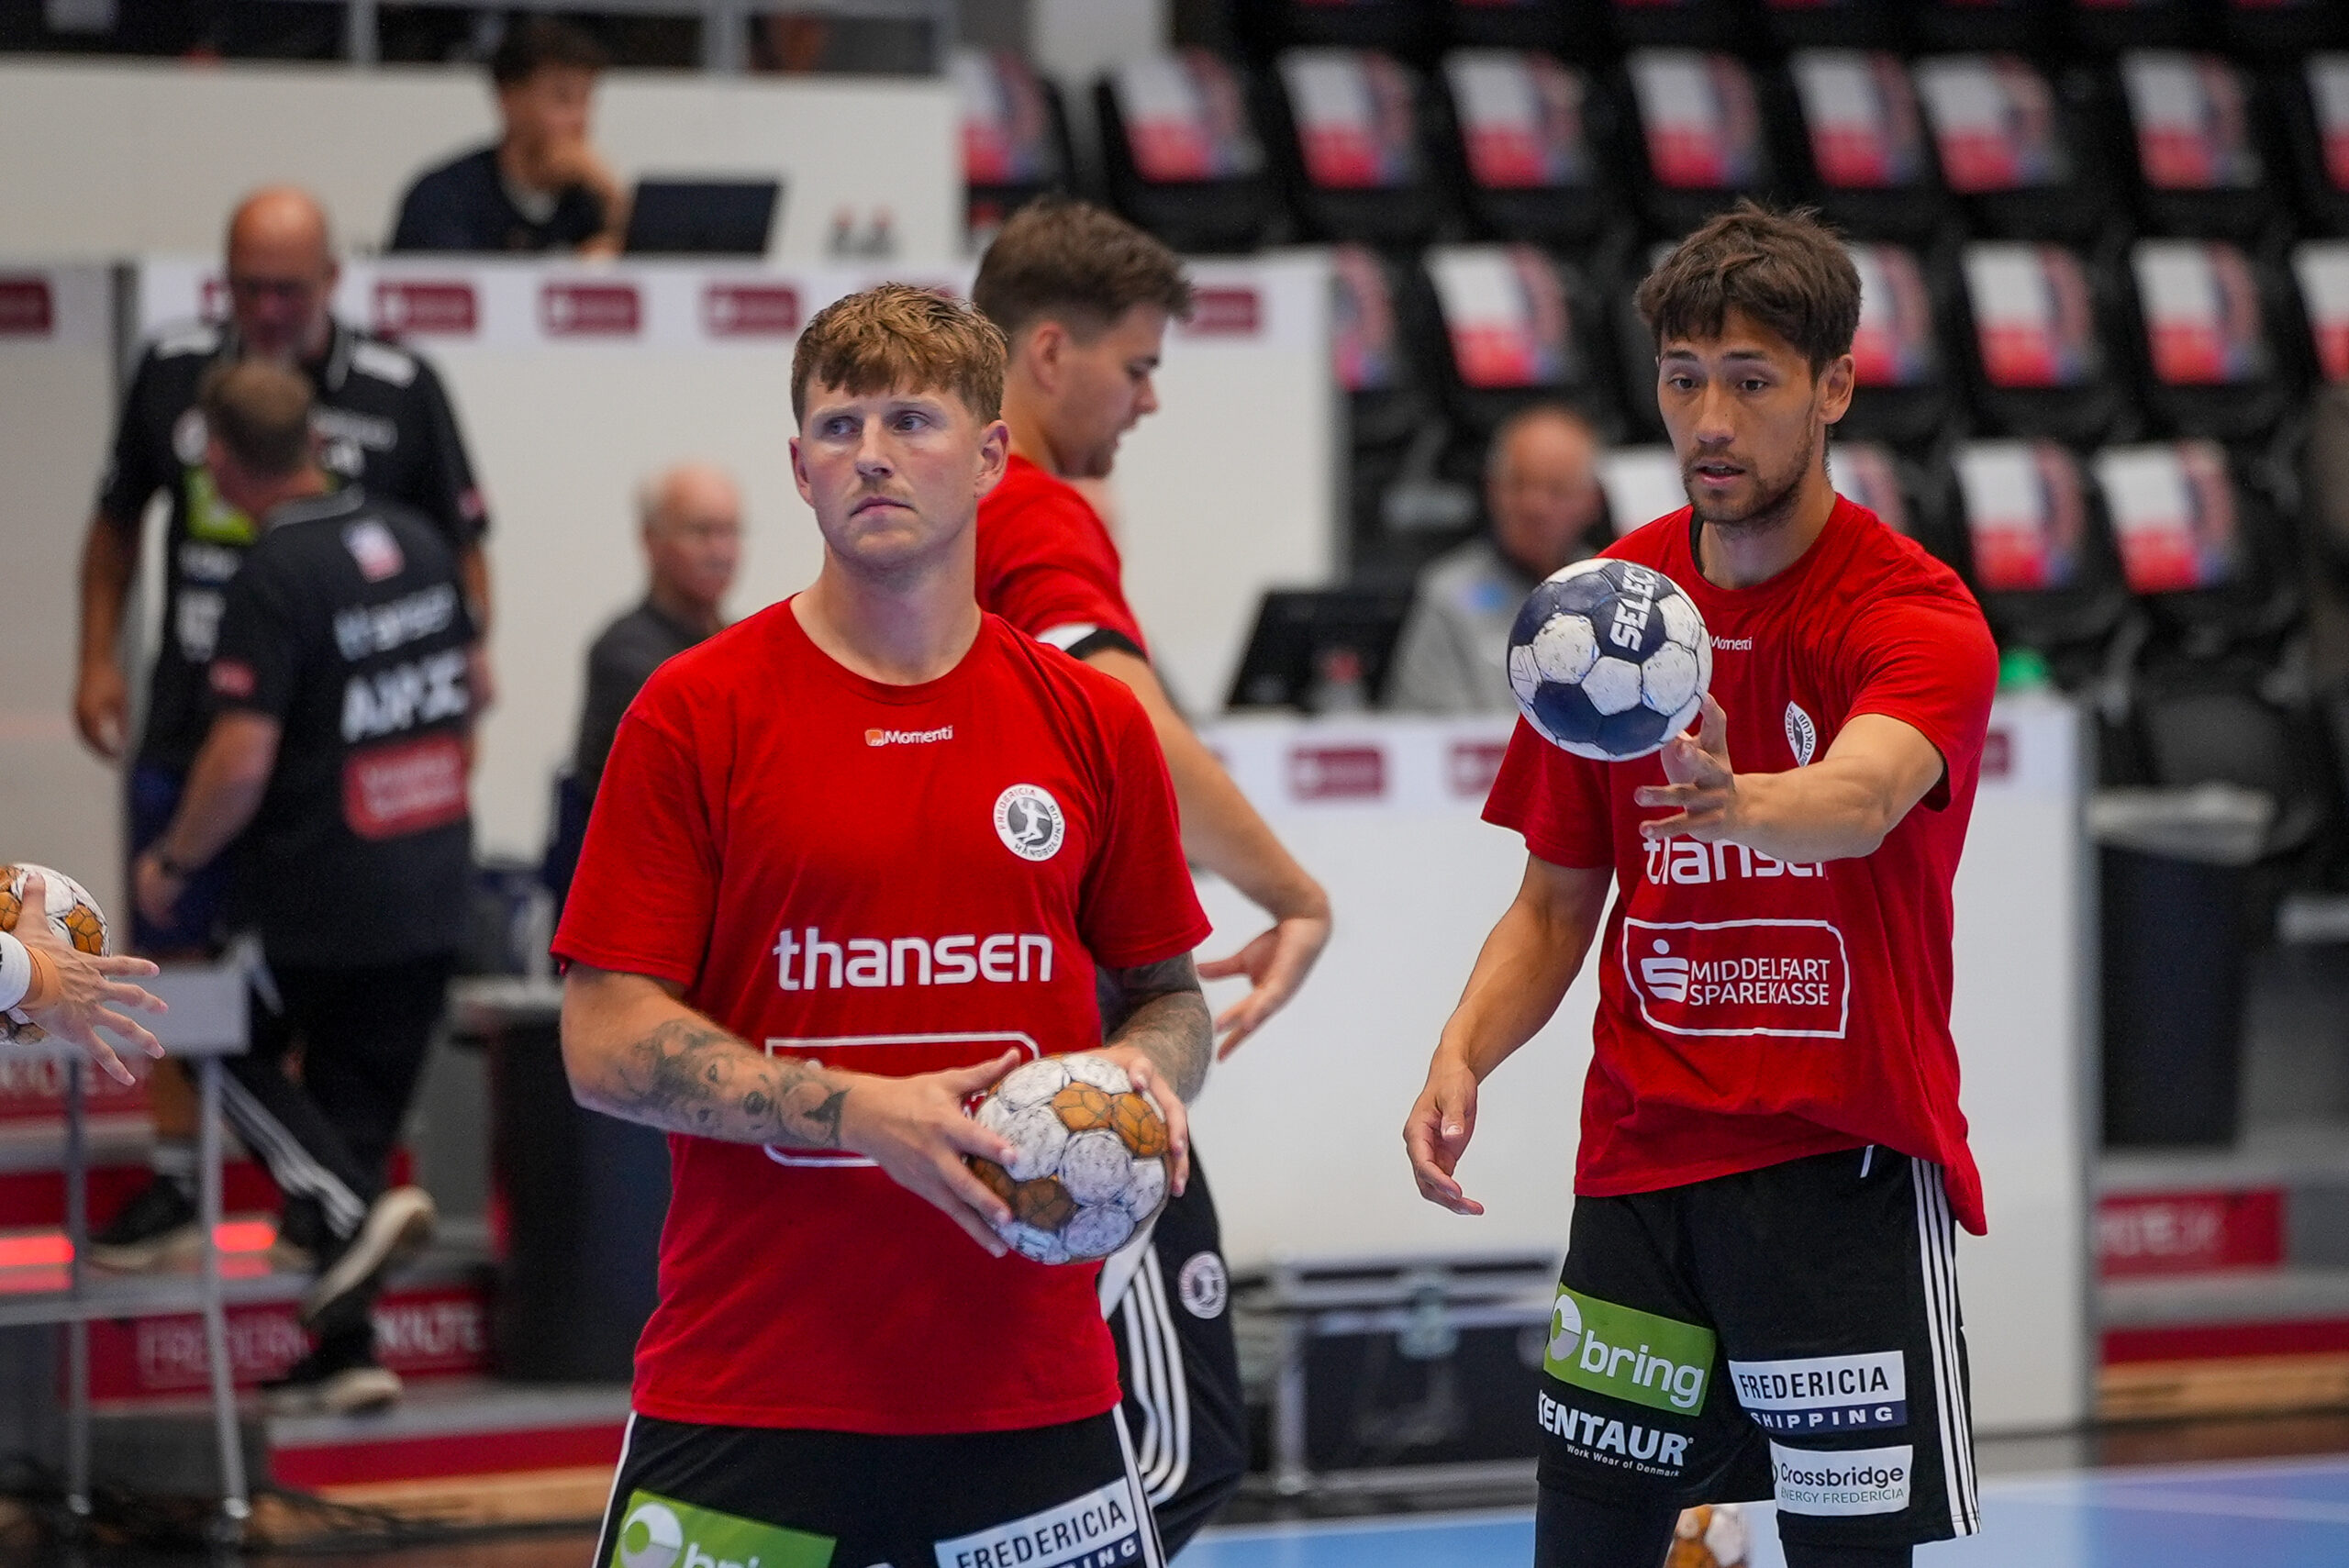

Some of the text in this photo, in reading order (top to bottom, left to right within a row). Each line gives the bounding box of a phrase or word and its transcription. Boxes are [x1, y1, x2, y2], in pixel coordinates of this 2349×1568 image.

[1609, 564, 1656, 652] SELEC
[885, 725, 953, 744] Momenti
[773, 927, 1052, 991] thansen
[1690, 958, 1831, 983] MIDDELFART
[1689, 982, 1830, 1006] SPAREKASSE
[1579, 1329, 1705, 1408] bring
[1738, 1366, 1889, 1399] FREDERICIA
[1750, 1407, 1893, 1429] SHIPPING
[1566, 1443, 1680, 1477] Work Wear of Denmark
[1781, 1462, 1904, 1488] Crossbridge
[1781, 1486, 1904, 1504] ENERGY FREDERICIA
[955, 1499, 1127, 1568] FREDERICIA
